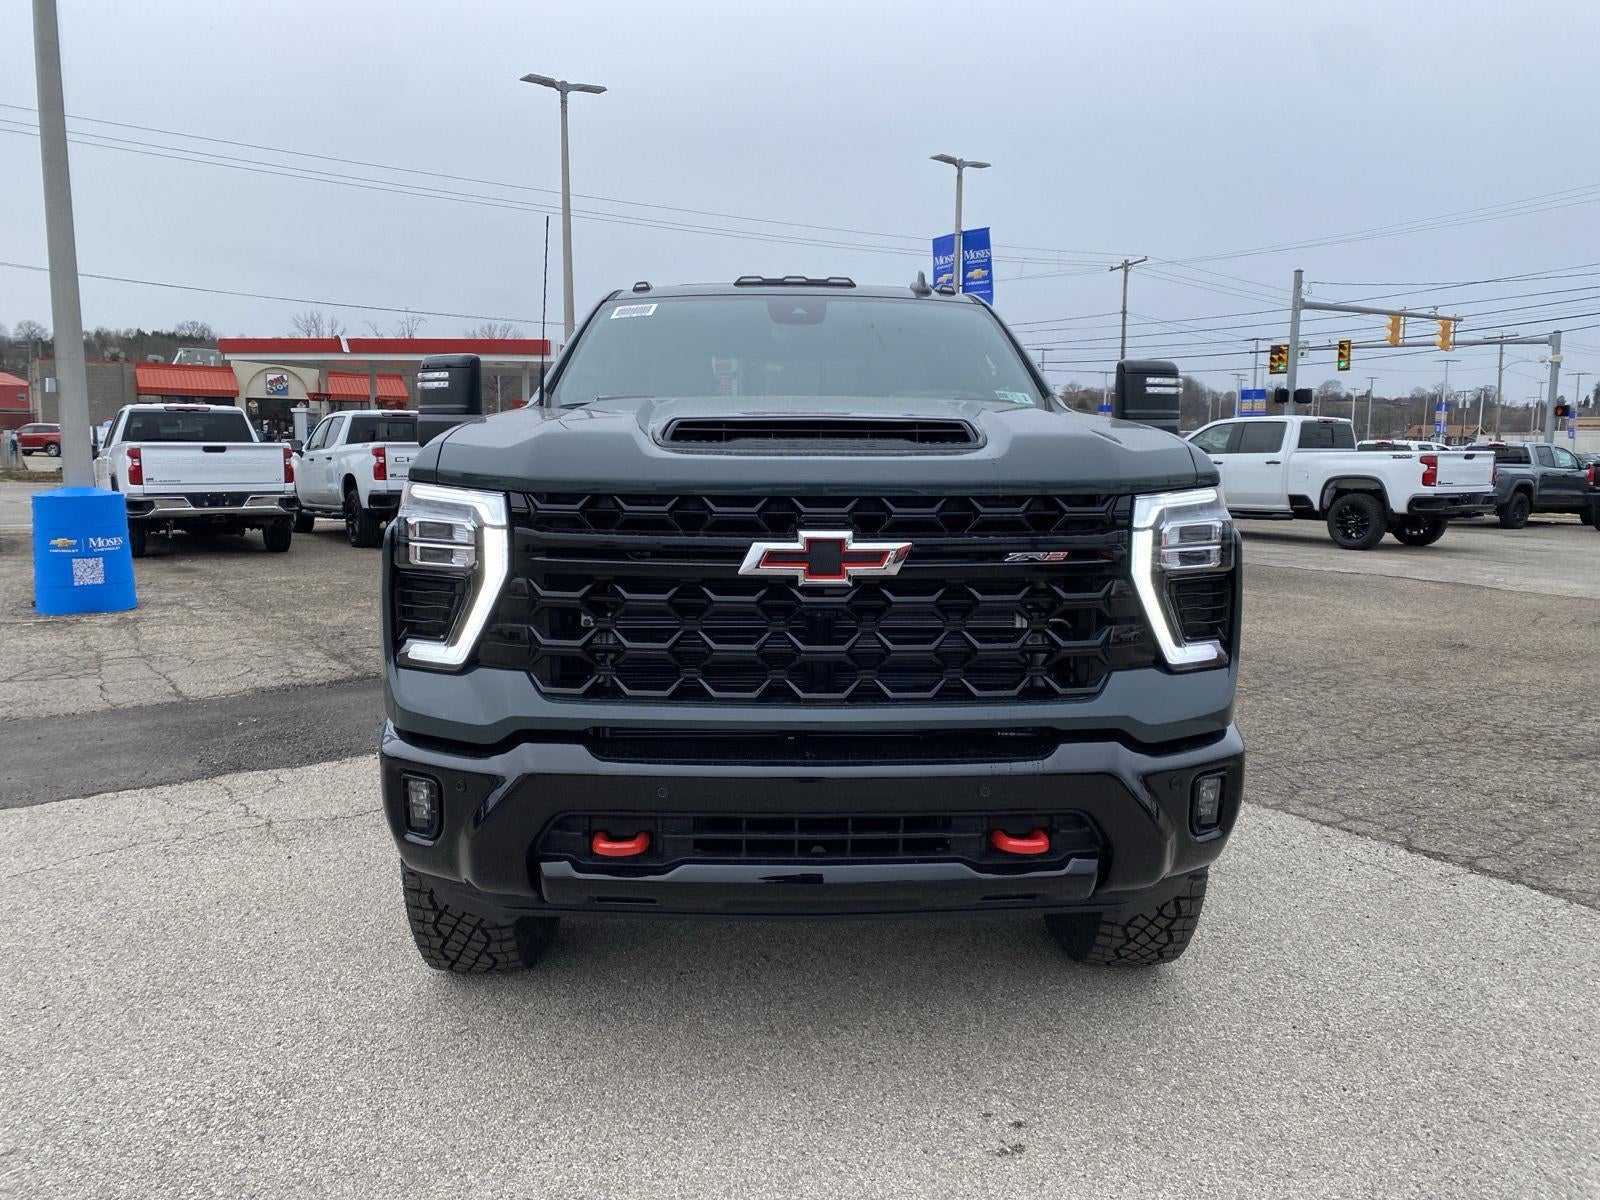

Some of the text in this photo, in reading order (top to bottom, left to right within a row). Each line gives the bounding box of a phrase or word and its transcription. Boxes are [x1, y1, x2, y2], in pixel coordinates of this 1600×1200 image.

[934, 253, 954, 267] MOSE
[963, 249, 991, 260] MOSES
[88, 536, 123, 548] MOSES
[1004, 551, 1069, 562] ZR2
